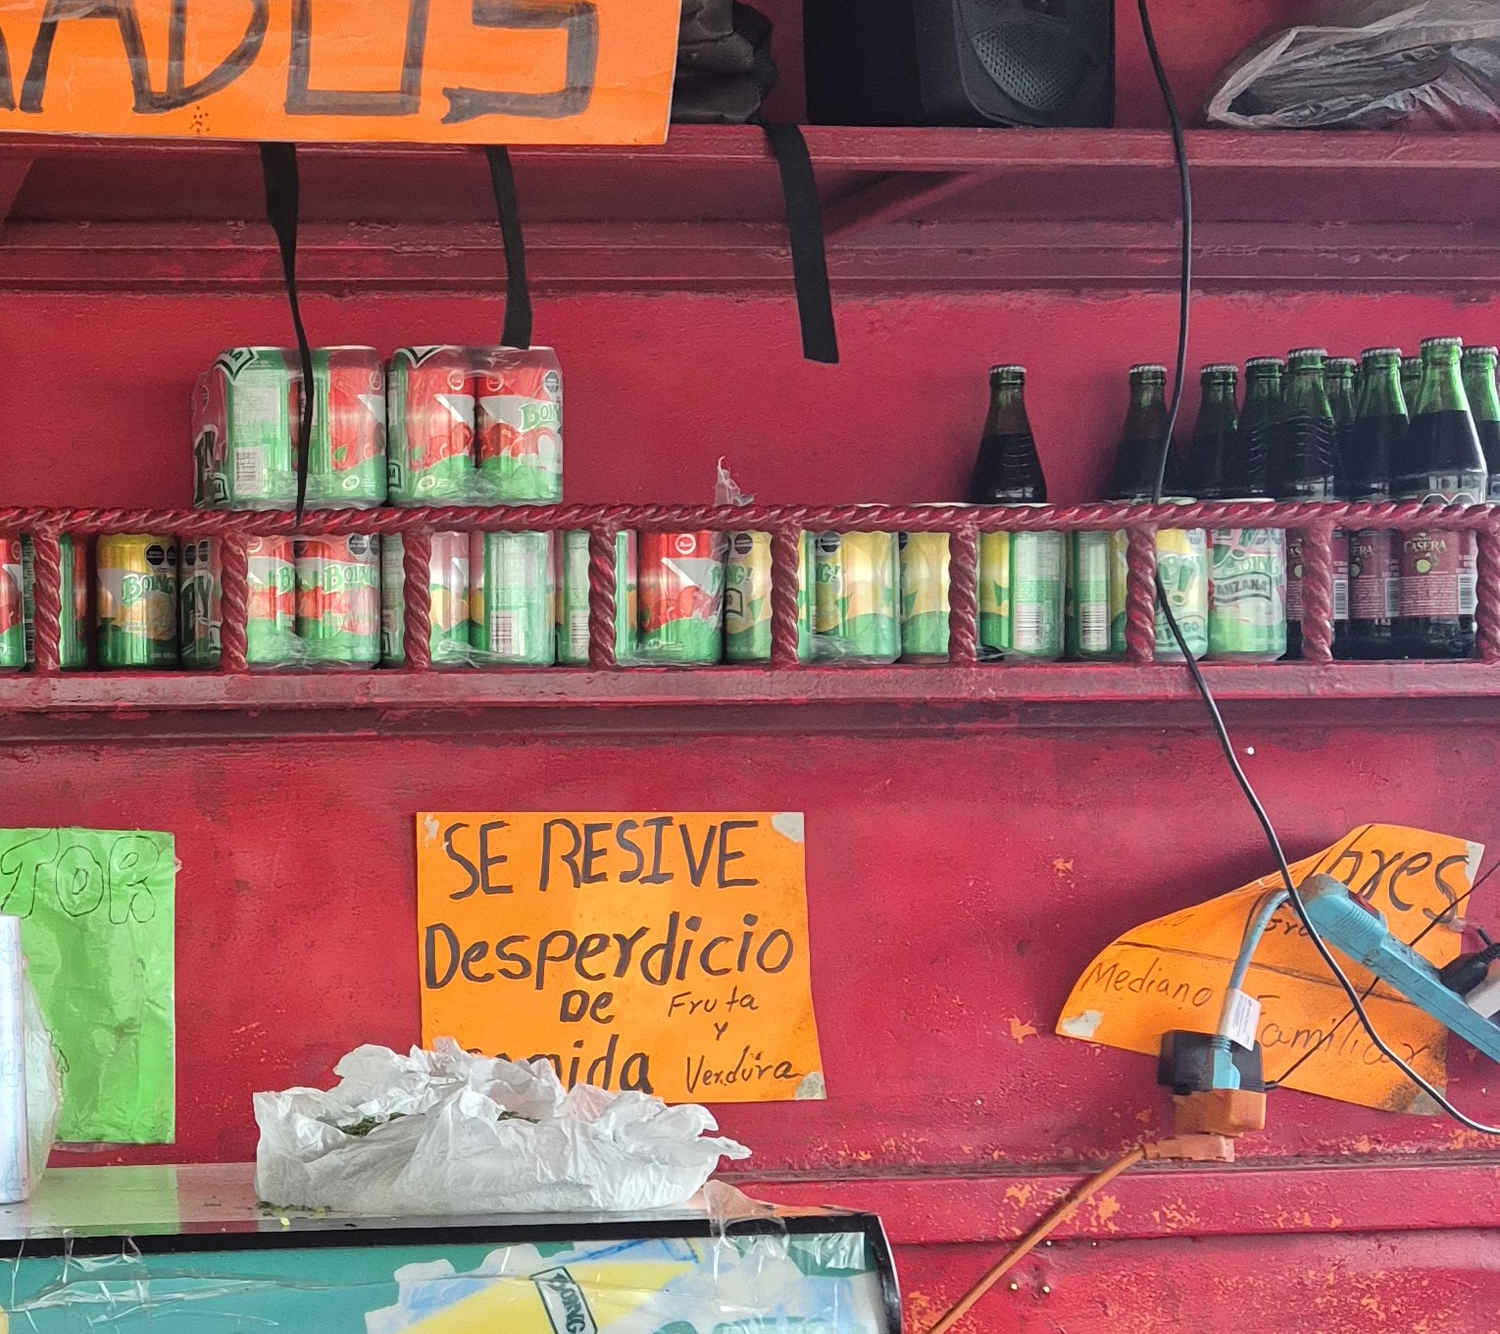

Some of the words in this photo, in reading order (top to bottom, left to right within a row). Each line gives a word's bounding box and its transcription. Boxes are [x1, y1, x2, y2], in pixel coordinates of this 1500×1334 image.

[1404, 539, 1447, 554] CASERA
[1216, 579, 1267, 595] ANZANA
[444, 821, 513, 900] SE
[539, 816, 758, 892] RESIVE
[425, 911, 794, 990] Desperdicio
[668, 986, 759, 1018] Fruta
[1082, 957, 1212, 1007] Mediano
